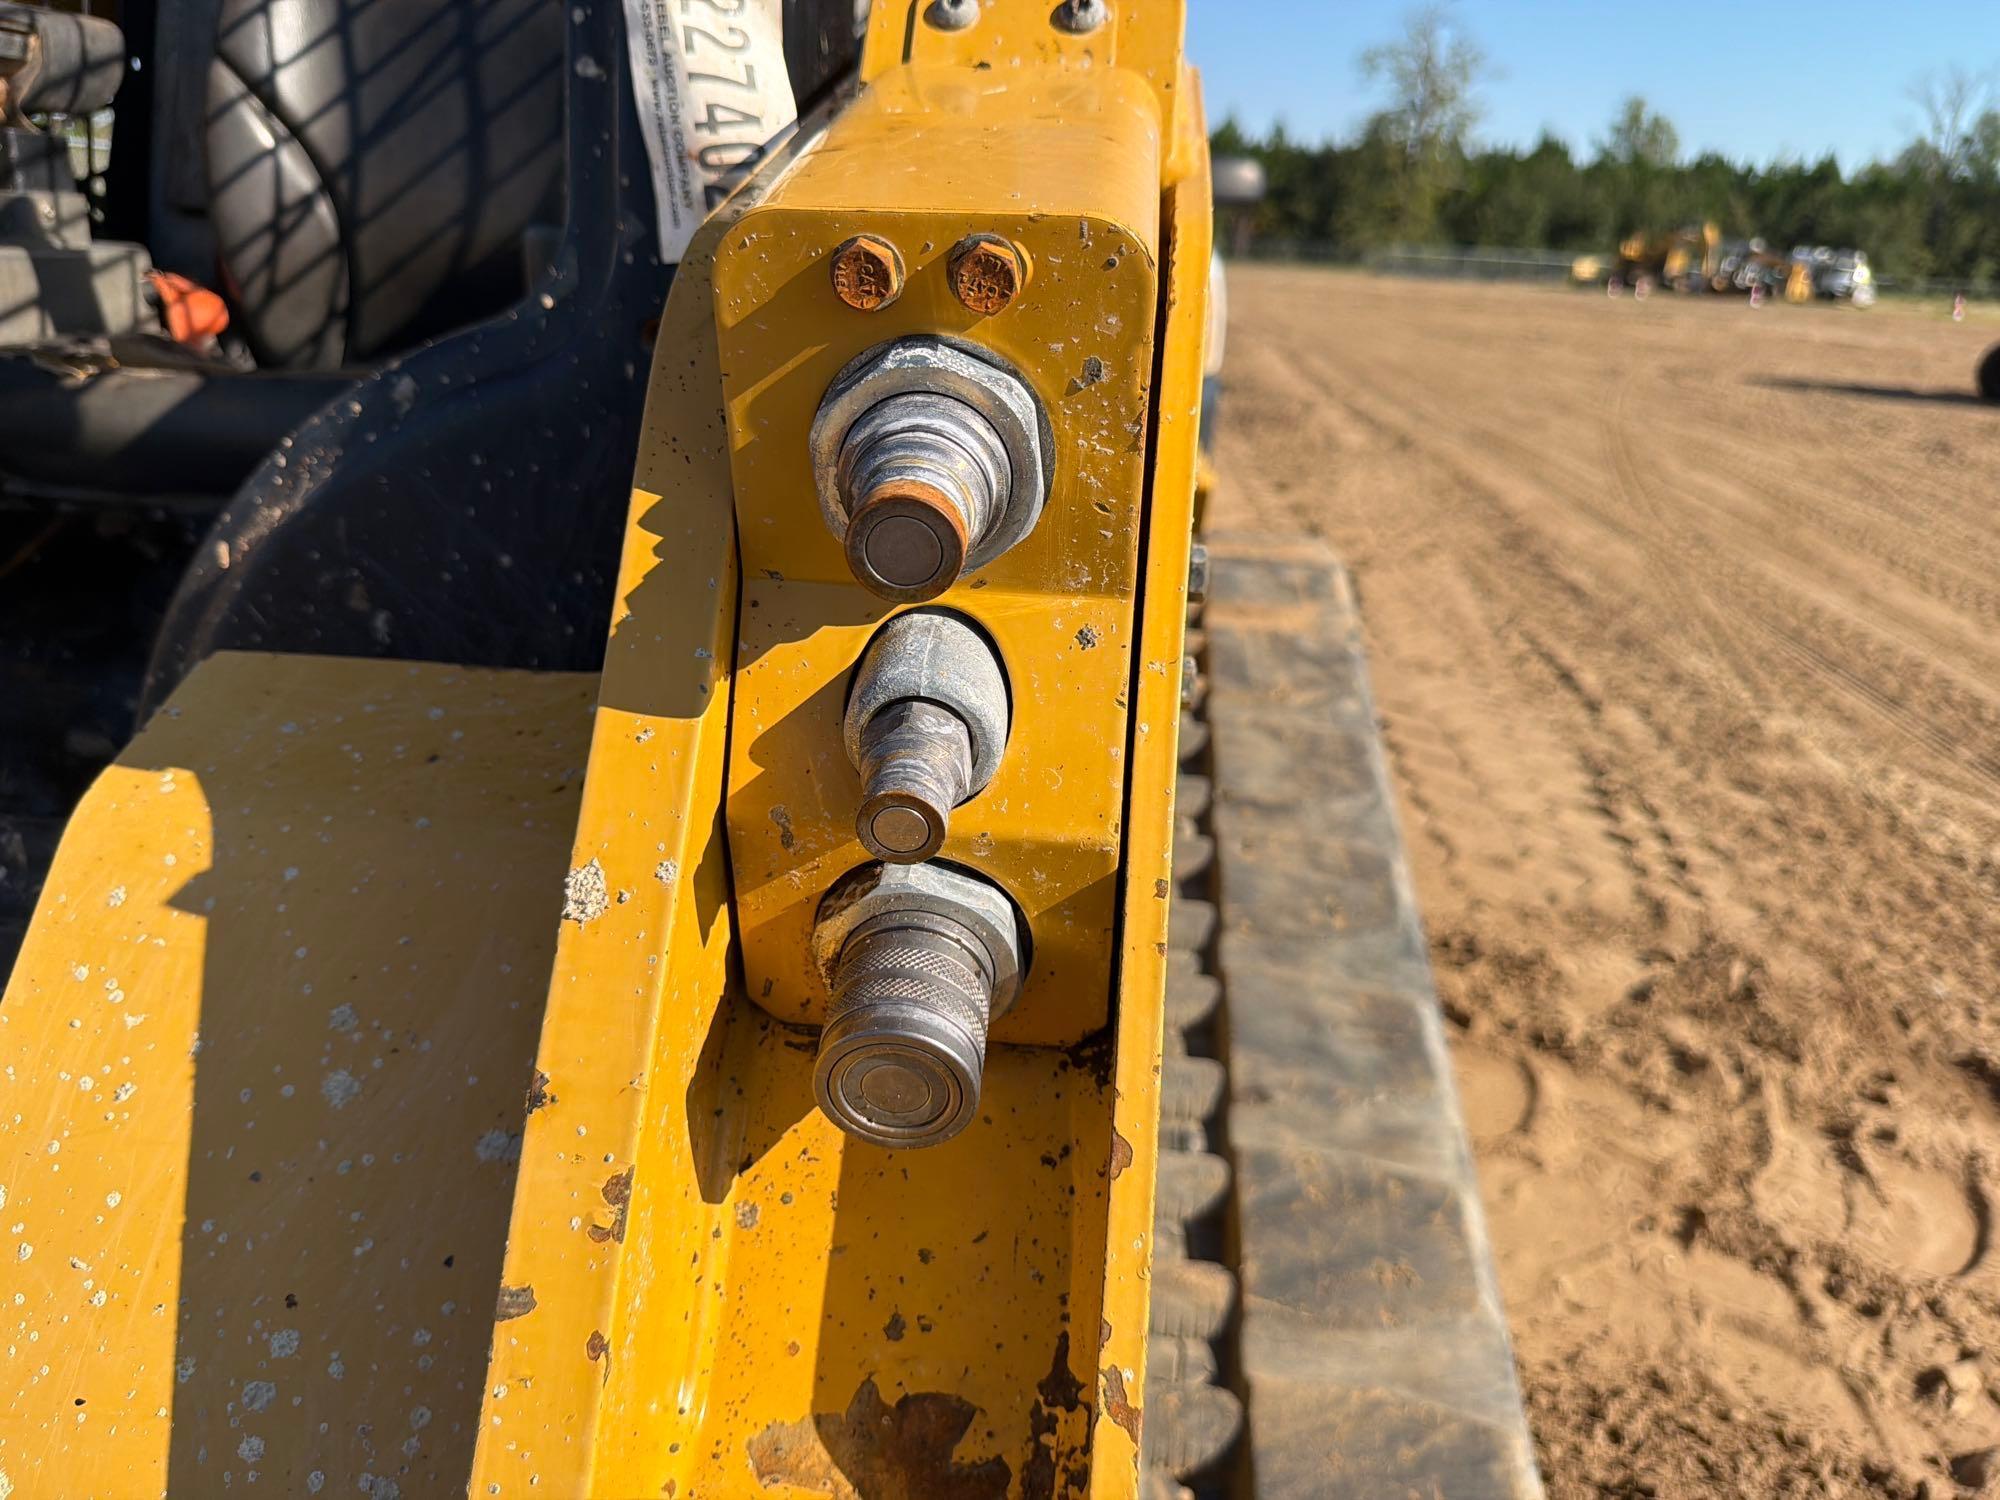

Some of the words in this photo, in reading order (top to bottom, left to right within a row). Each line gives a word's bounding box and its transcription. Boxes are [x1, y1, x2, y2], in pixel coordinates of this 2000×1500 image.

[655, 0, 671, 44] EBEL
[661, 51, 681, 124] AUCTION
[673, 129, 693, 208] COMPANY
[859, 263, 876, 295] CAT
